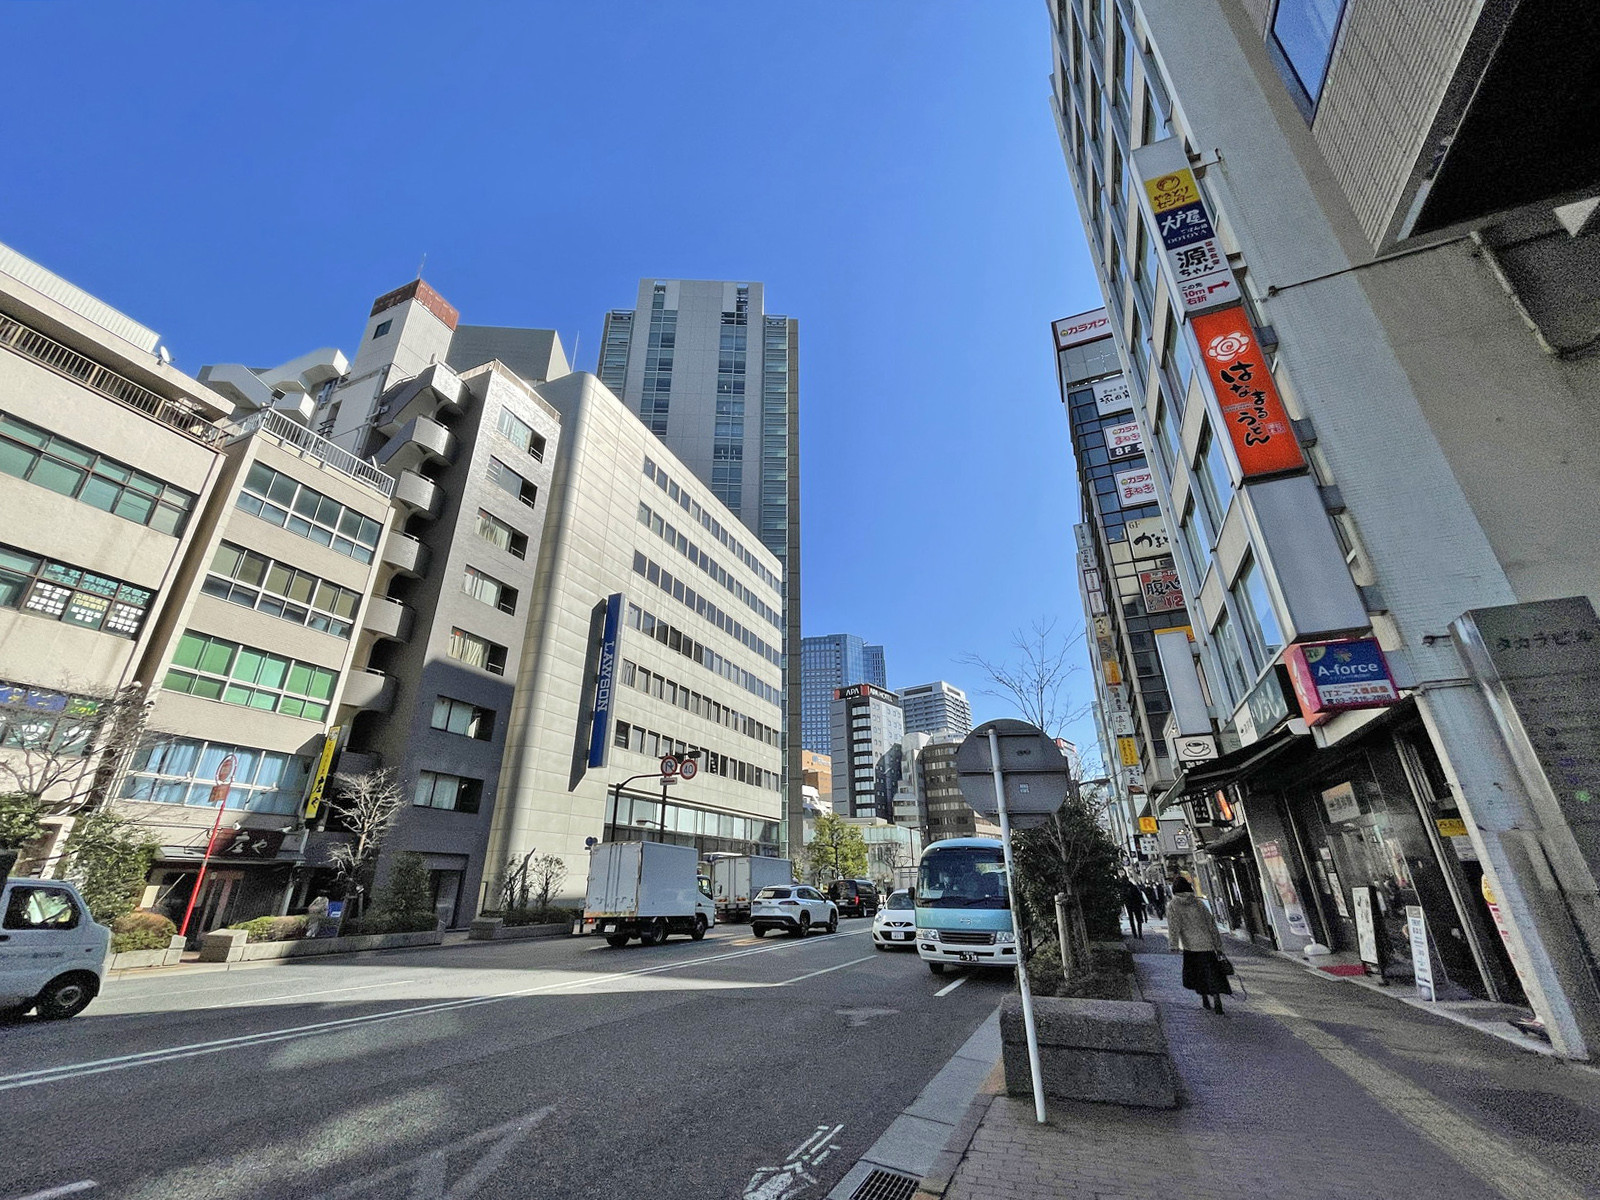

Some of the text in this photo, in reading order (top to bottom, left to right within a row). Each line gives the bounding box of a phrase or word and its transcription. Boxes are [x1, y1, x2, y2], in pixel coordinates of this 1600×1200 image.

[1161, 209, 1206, 237] 大戸屋
[1175, 246, 1209, 269] 源
[1179, 263, 1215, 278] ちゃん
[1183, 289, 1206, 299] 10m
[1186, 295, 1207, 306] 右折
[1115, 446, 1132, 457] 8F
[1318, 663, 1378, 677] A-force
[597, 641, 614, 712] LAWSON
[846, 687, 860, 696] APA
[683, 764, 694, 774] 40
